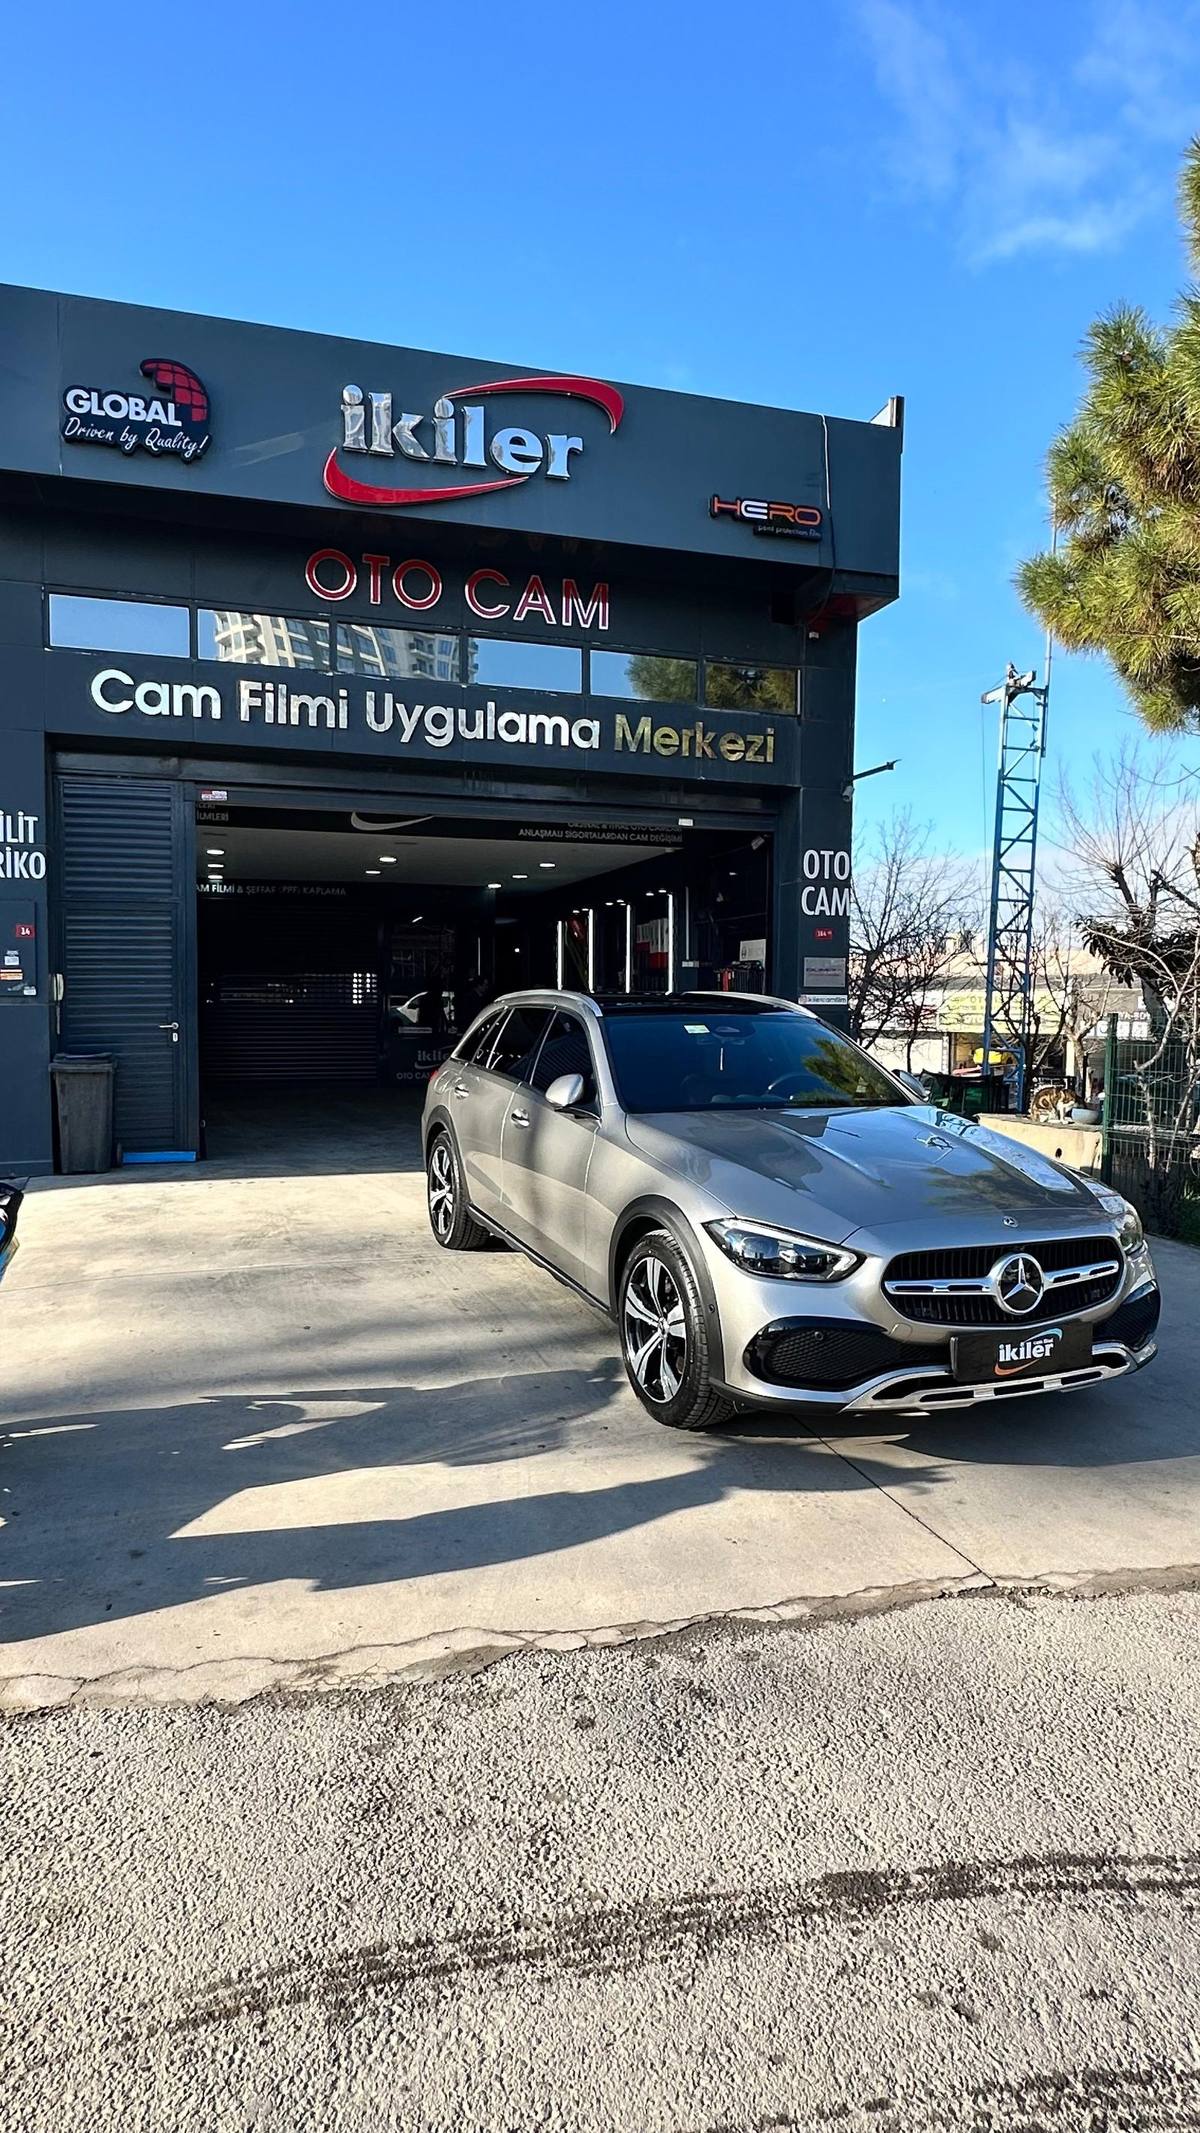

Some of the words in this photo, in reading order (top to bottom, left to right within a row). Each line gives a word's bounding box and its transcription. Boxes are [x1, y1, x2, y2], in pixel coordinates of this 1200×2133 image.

[65, 388, 182, 427] GLOBAL
[64, 416, 115, 441] Driven
[119, 425, 139, 450] by
[144, 427, 209, 458] Quality!
[340, 384, 584, 481] ikiler
[714, 496, 821, 526] HERO
[304, 548, 443, 611] OTO
[464, 568, 610, 630] CAM
[90, 668, 222, 720] Cam
[238, 679, 349, 730] Filmi
[365, 690, 601, 750] Uygulama
[613, 713, 776, 764] Merkezi
[0, 810, 39, 843] İLİT
[0, 846, 46, 879] RİKO
[803, 849, 850, 880] OTO
[801, 886, 850, 916] CAM
[998, 1341, 1054, 1362] ikiler
